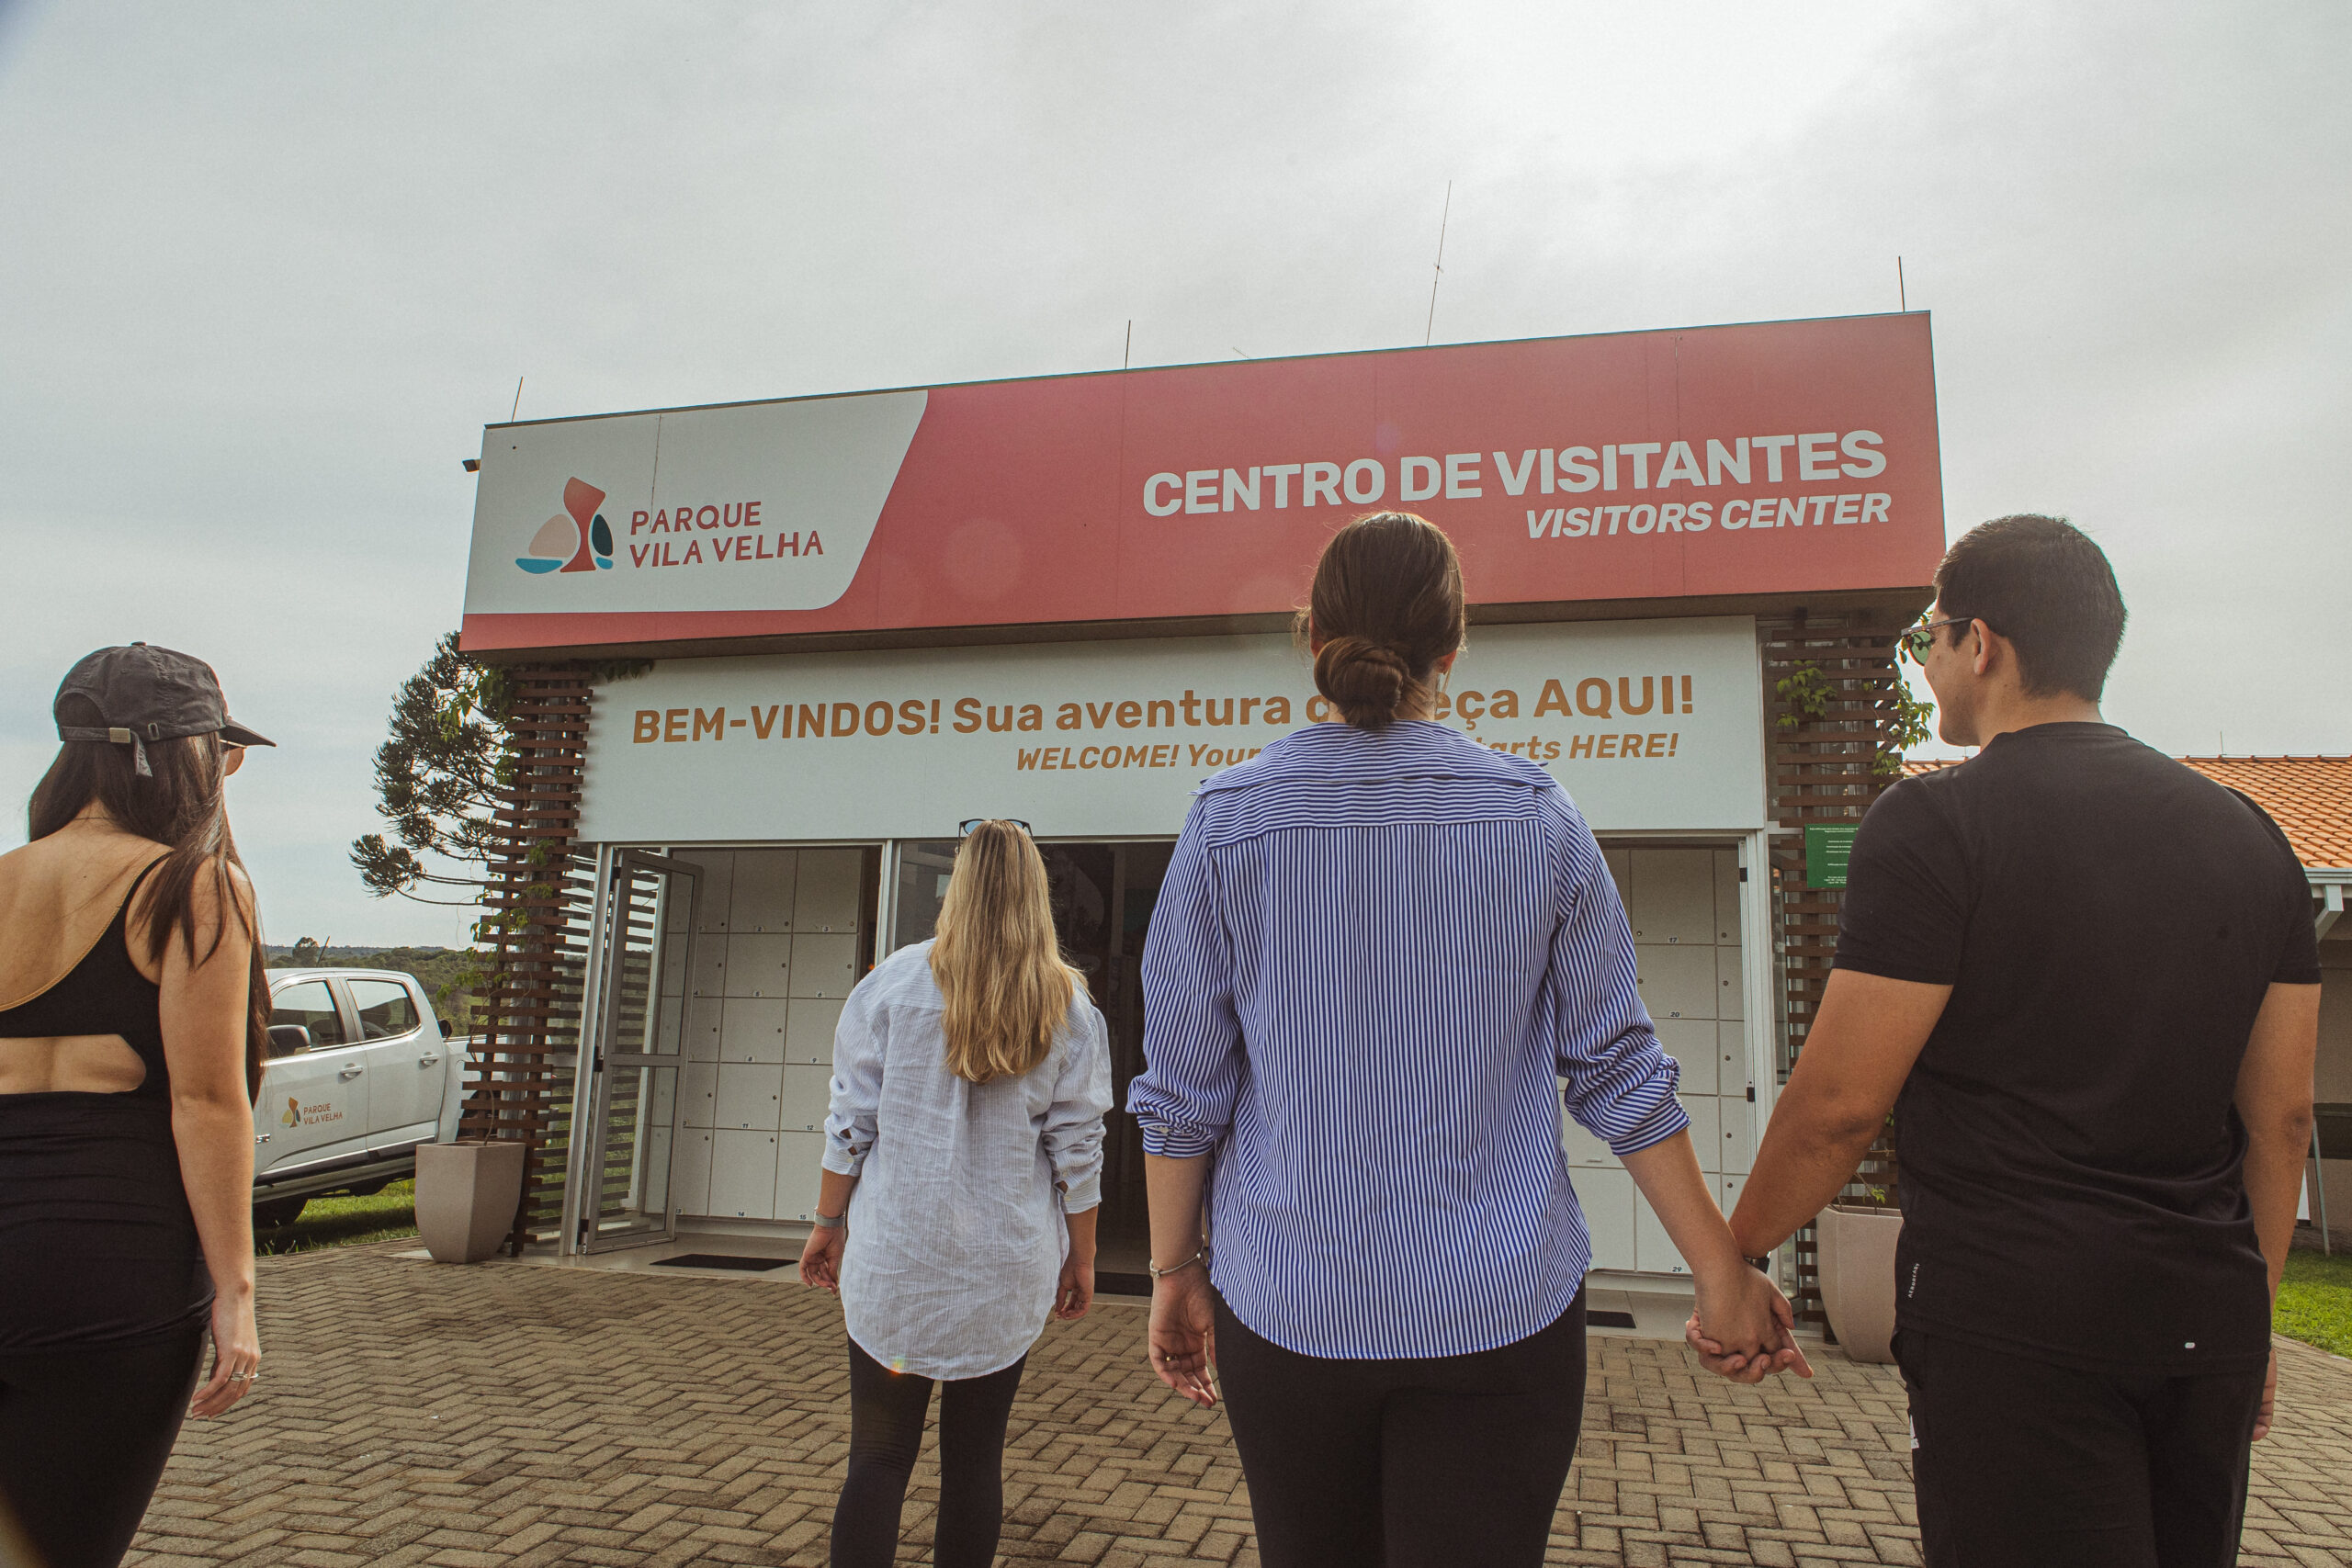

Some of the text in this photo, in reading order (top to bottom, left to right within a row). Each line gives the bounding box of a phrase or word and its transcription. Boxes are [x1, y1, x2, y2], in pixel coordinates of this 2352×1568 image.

[1143, 429, 1887, 517] CENTRO DE VISITANTES
[630, 501, 762, 536] PARQUE
[1526, 492, 1892, 539] VISITORS CENTER
[629, 530, 823, 569] VILA VELHA
[633, 699, 941, 744] BEM-VINDOS!
[953, 697, 1043, 734] Sua
[1056, 690, 1291, 730] aventura
[1533, 675, 1693, 719] AQUI!
[1017, 744, 1180, 771] WELCOME!
[1188, 744, 1261, 767] Your
[1569, 732, 1679, 760] HERE!
[304, 1103, 331, 1115] PARQUE
[304, 1111, 343, 1125] VILA VELHA
